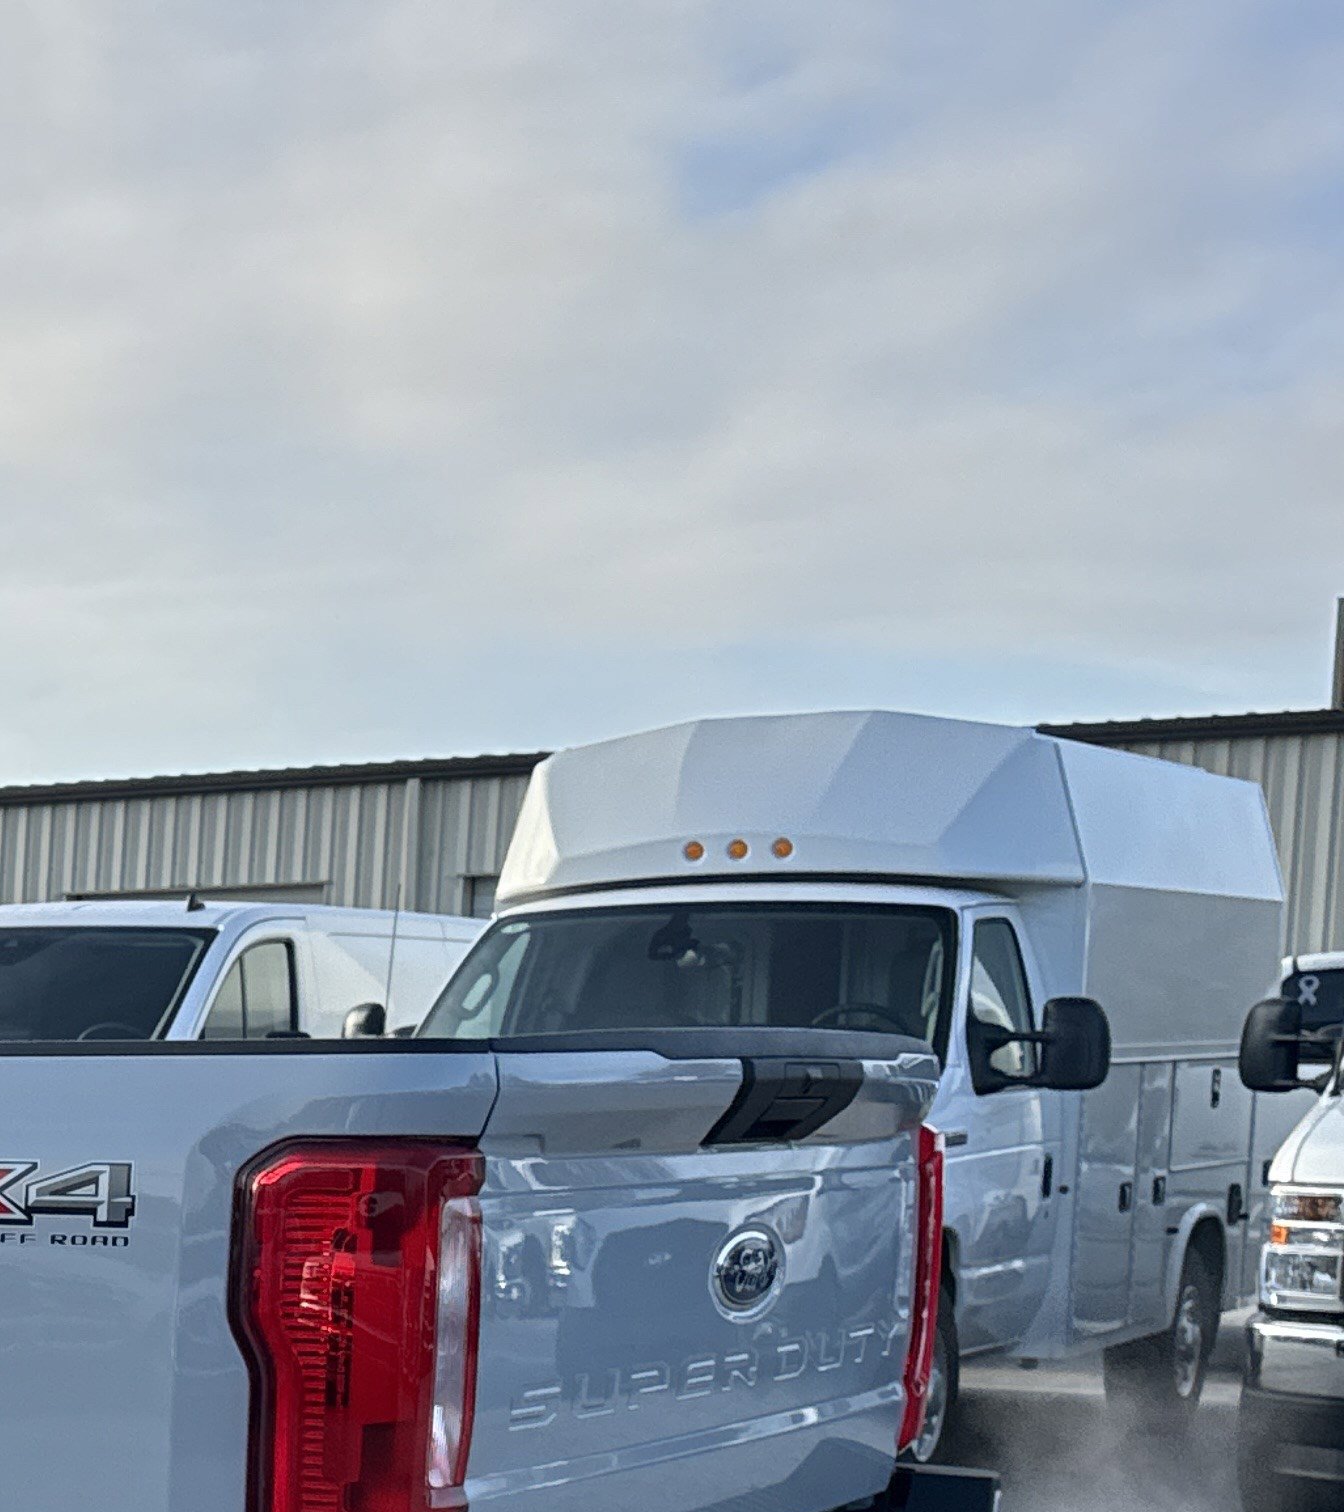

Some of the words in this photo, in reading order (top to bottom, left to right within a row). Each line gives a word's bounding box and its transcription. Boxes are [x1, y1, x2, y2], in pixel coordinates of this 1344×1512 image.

[50, 1234, 130, 1248] ROAD
[508, 1352, 759, 1433] SUPER
[773, 1320, 908, 1382] DUTY
